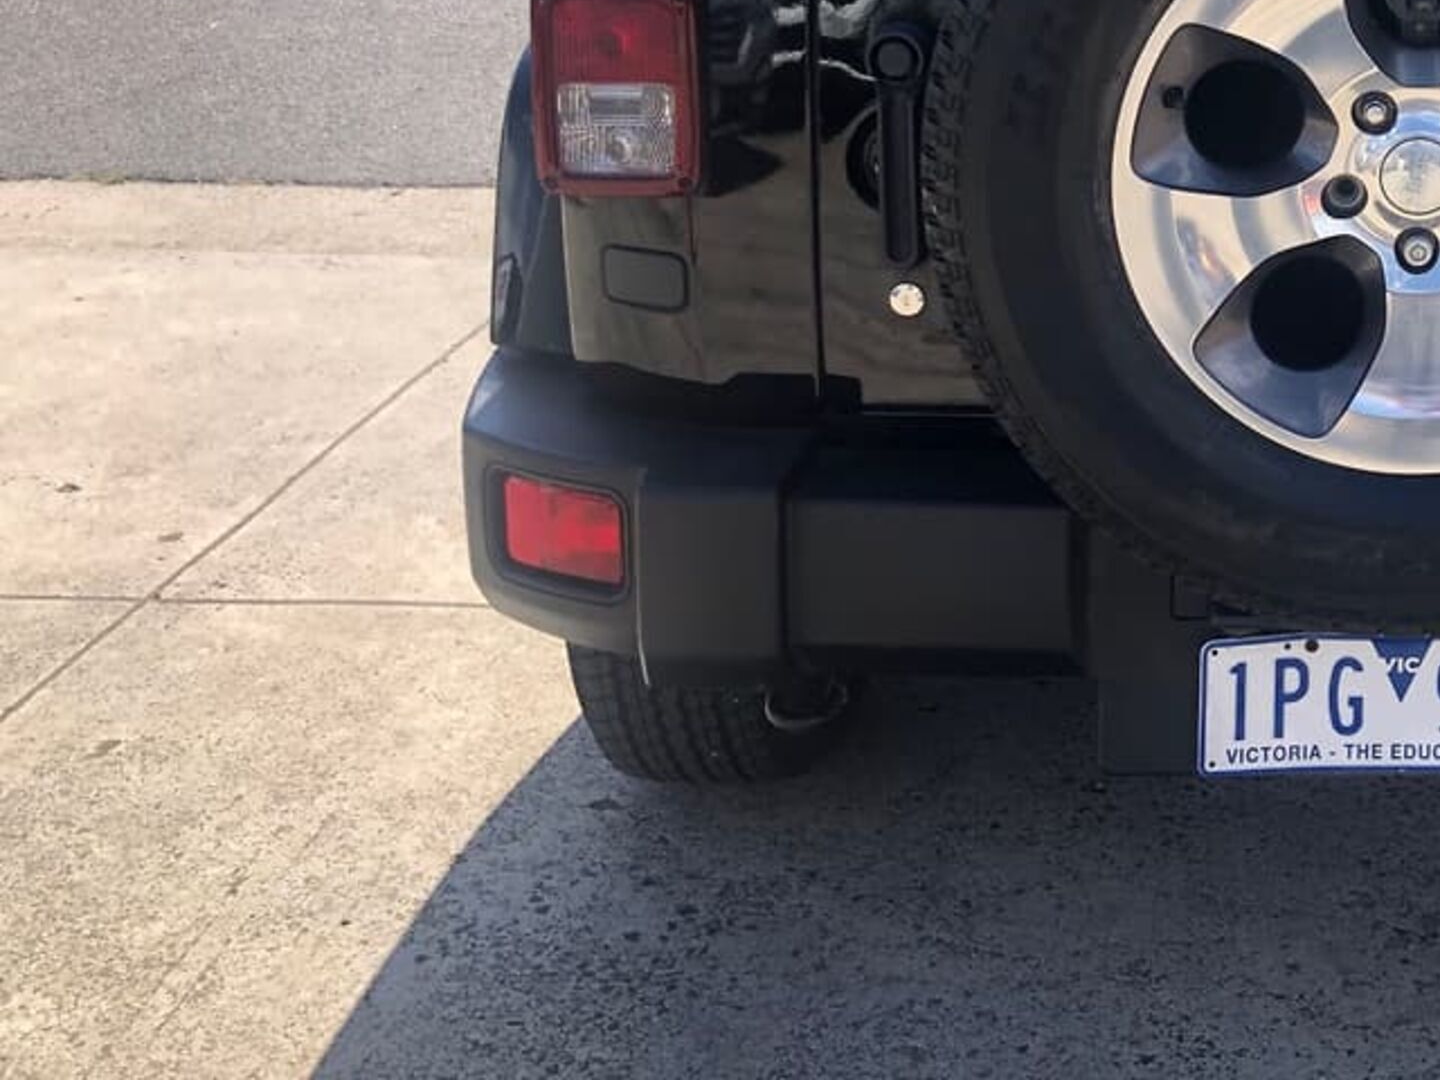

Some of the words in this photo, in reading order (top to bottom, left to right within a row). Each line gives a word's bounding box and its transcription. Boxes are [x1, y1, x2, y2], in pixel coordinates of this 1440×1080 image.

[1384, 657, 1421, 674] VIC
[1230, 657, 1364, 741] 1PG
[1226, 745, 1322, 764] VICTORIA
[1344, 744, 1382, 760] THE
